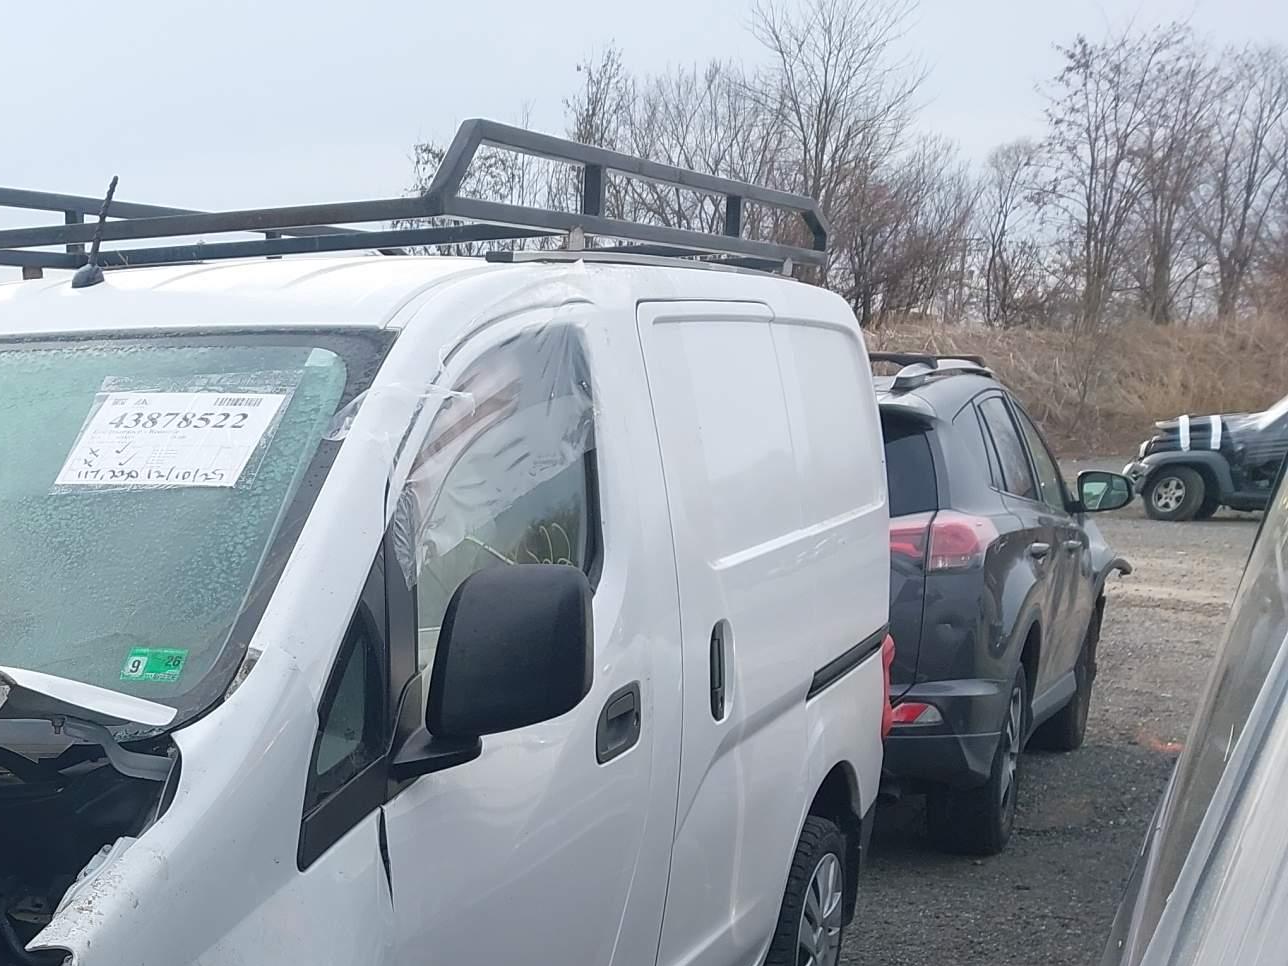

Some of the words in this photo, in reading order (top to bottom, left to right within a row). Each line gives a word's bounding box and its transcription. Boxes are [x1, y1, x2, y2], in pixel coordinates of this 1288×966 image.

[108, 412, 249, 429] 43878522
[147, 466, 225, 482] 12/10/25
[129, 659, 142, 674] 9
[164, 655, 183, 668] 26
